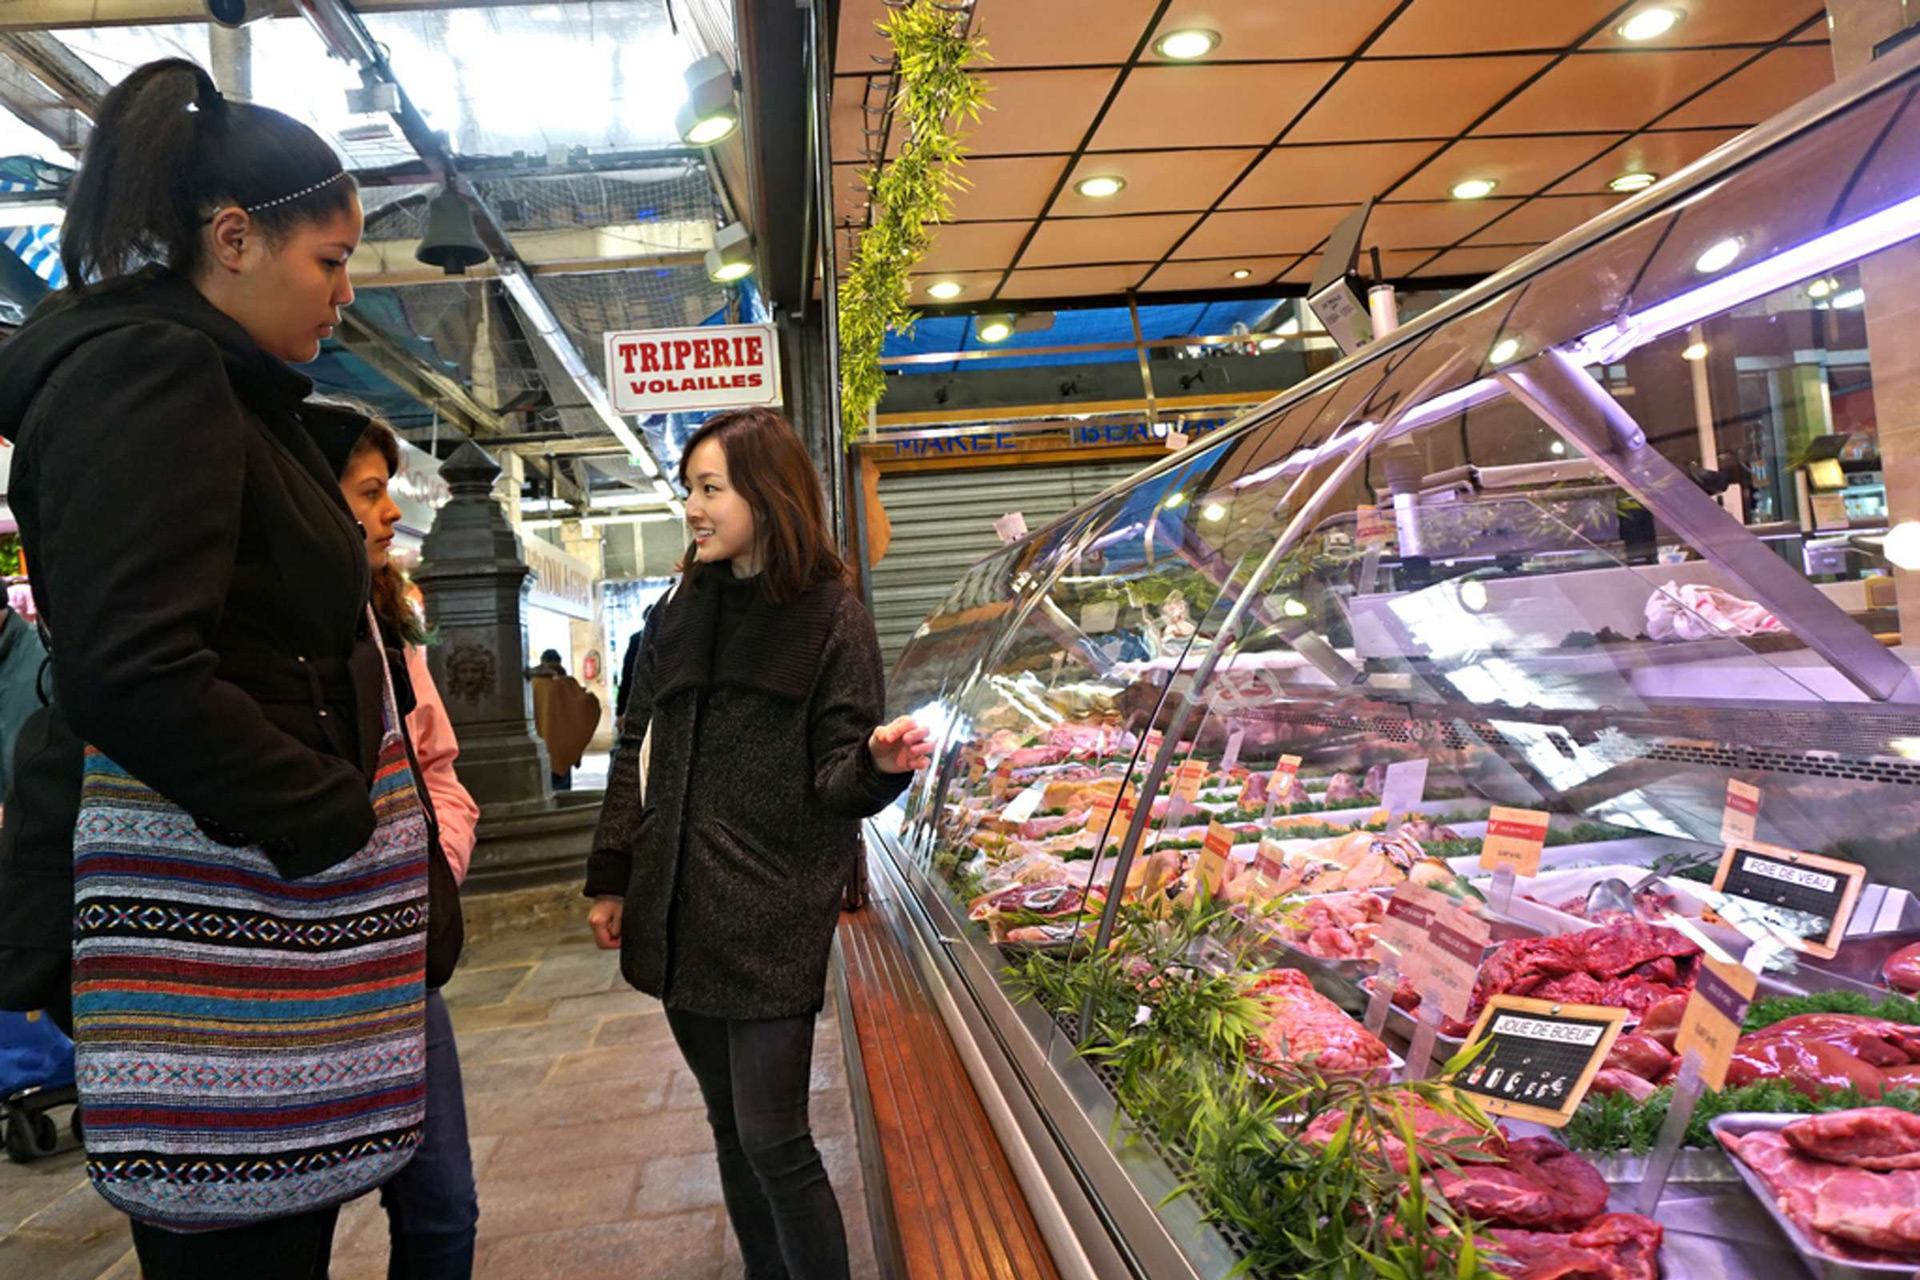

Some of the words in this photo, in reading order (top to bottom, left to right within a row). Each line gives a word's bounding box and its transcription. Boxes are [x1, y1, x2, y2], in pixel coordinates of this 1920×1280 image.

[618, 336, 764, 374] TRIPERIE
[630, 374, 763, 394] VOLAILLES
[1751, 861, 1775, 875] FOIE
[1778, 869, 1794, 881] DE
[1798, 873, 1830, 889] VEAU
[1498, 1018, 1531, 1034] JOUE
[1531, 1023, 1549, 1037] DE
[1549, 1025, 1595, 1041] BOEUF
